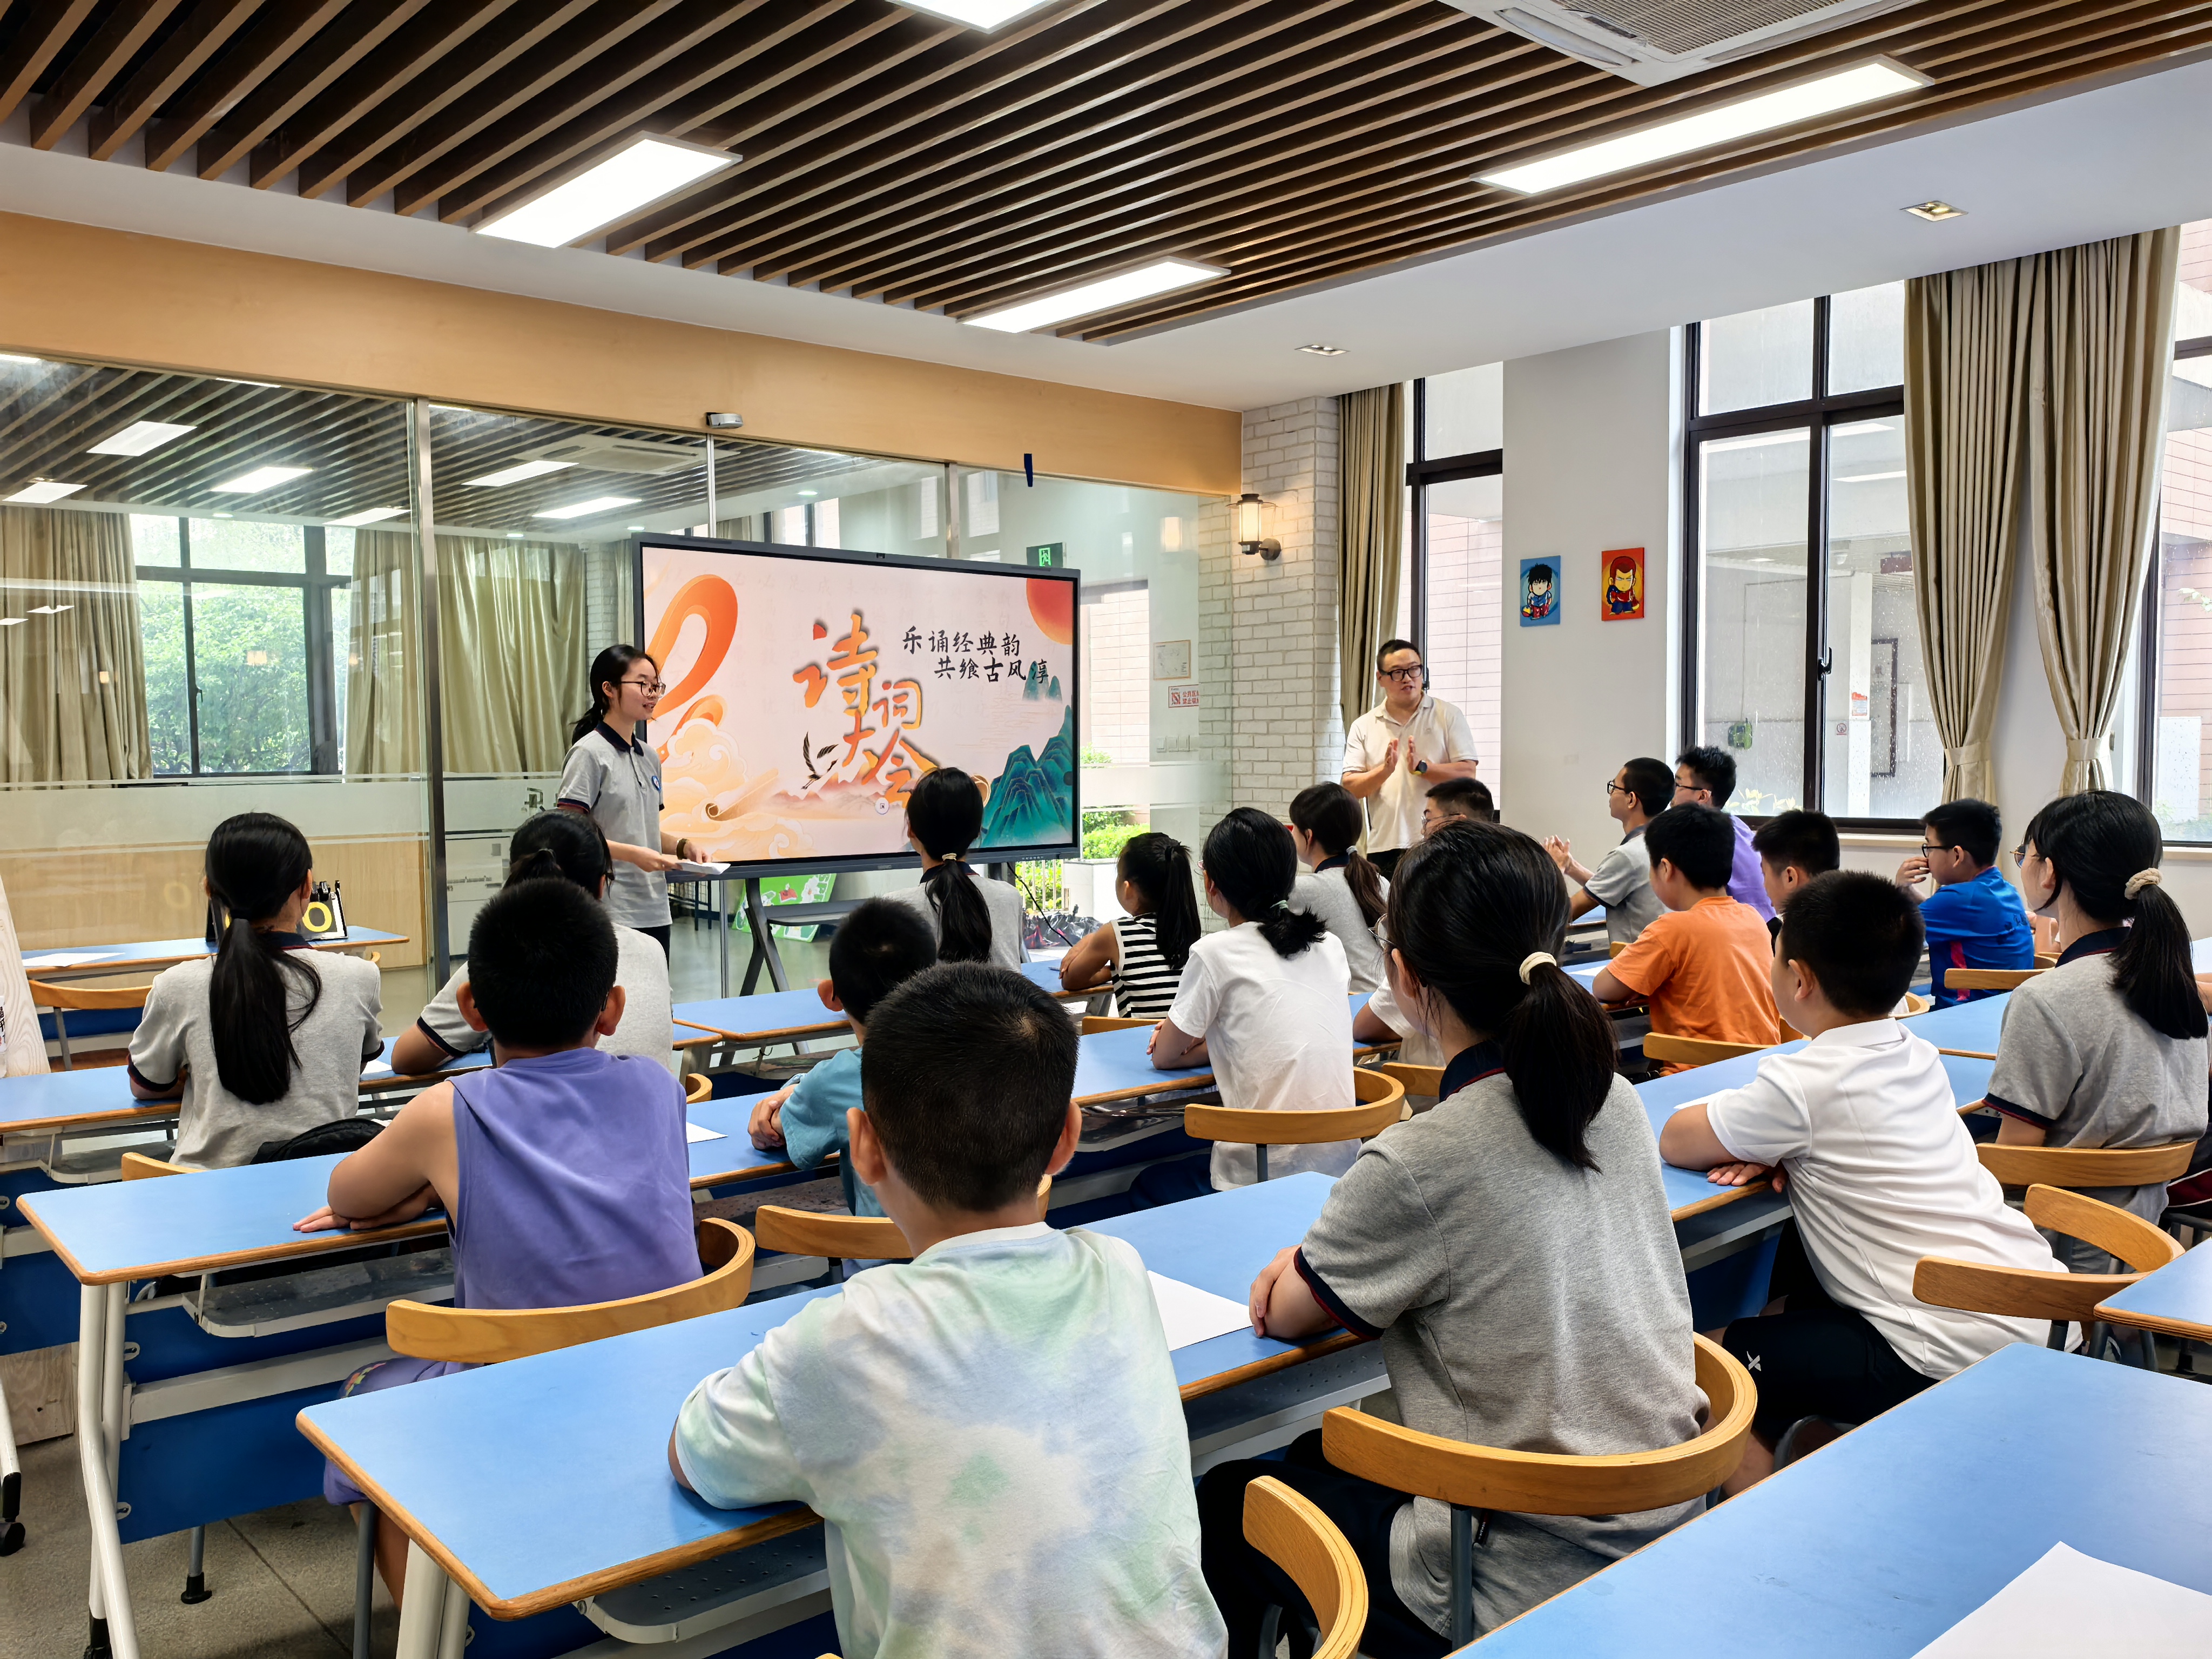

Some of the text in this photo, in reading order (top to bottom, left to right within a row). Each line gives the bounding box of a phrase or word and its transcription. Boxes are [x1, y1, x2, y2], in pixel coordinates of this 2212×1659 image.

[902, 625, 1020, 656] 乐诵经典韵
[934, 656, 1049, 683] 共飨古风淳
